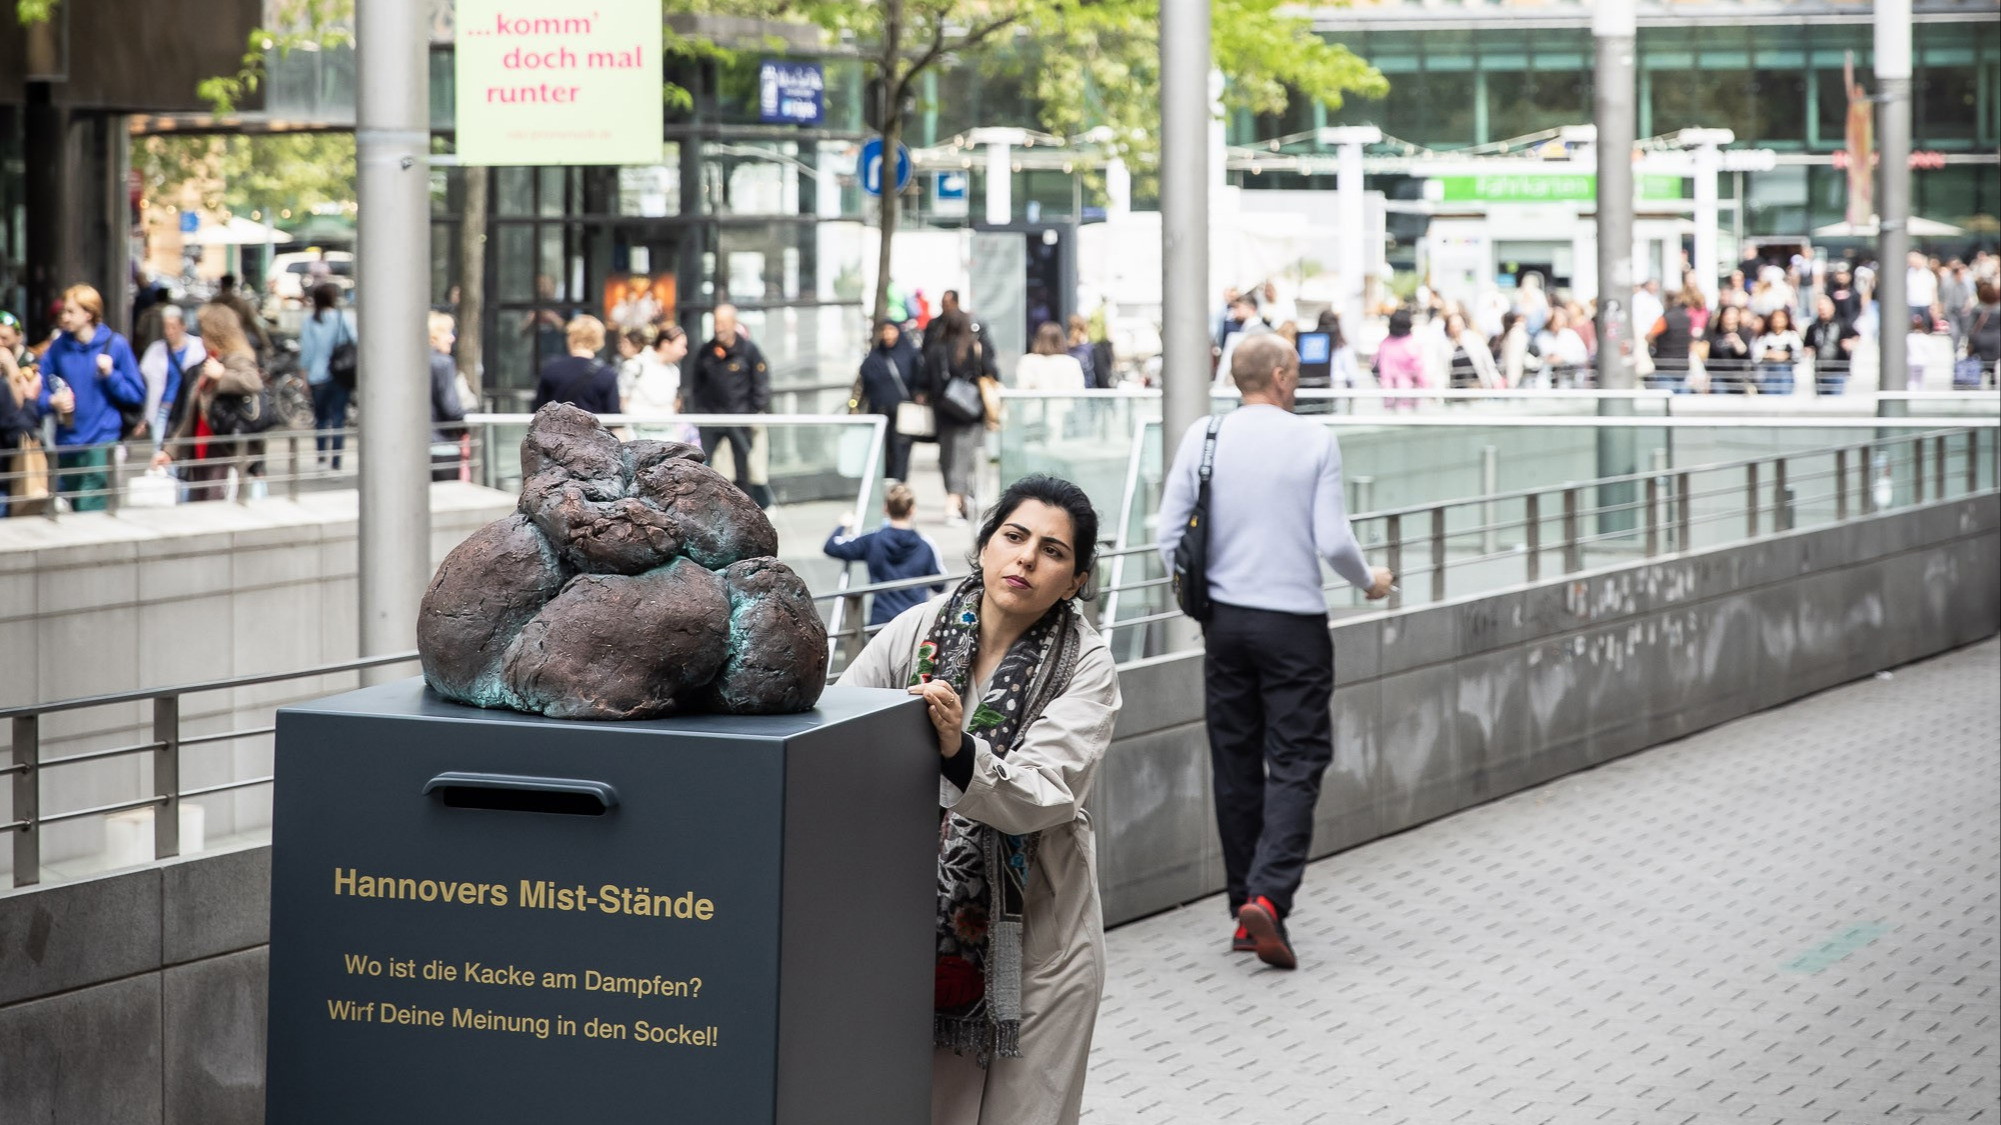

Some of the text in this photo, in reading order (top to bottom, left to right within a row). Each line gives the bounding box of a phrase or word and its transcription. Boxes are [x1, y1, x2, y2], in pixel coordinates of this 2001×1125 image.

[503, 45, 642, 69] doch mal
[487, 83, 580, 103] runter
[334, 868, 715, 921] Hannovers Mist-Stände
[345, 954, 703, 998] Wo ist die Kacke am Dampfen?
[328, 1000, 719, 1047] Wirf Deine Meinung in den Sockel!
